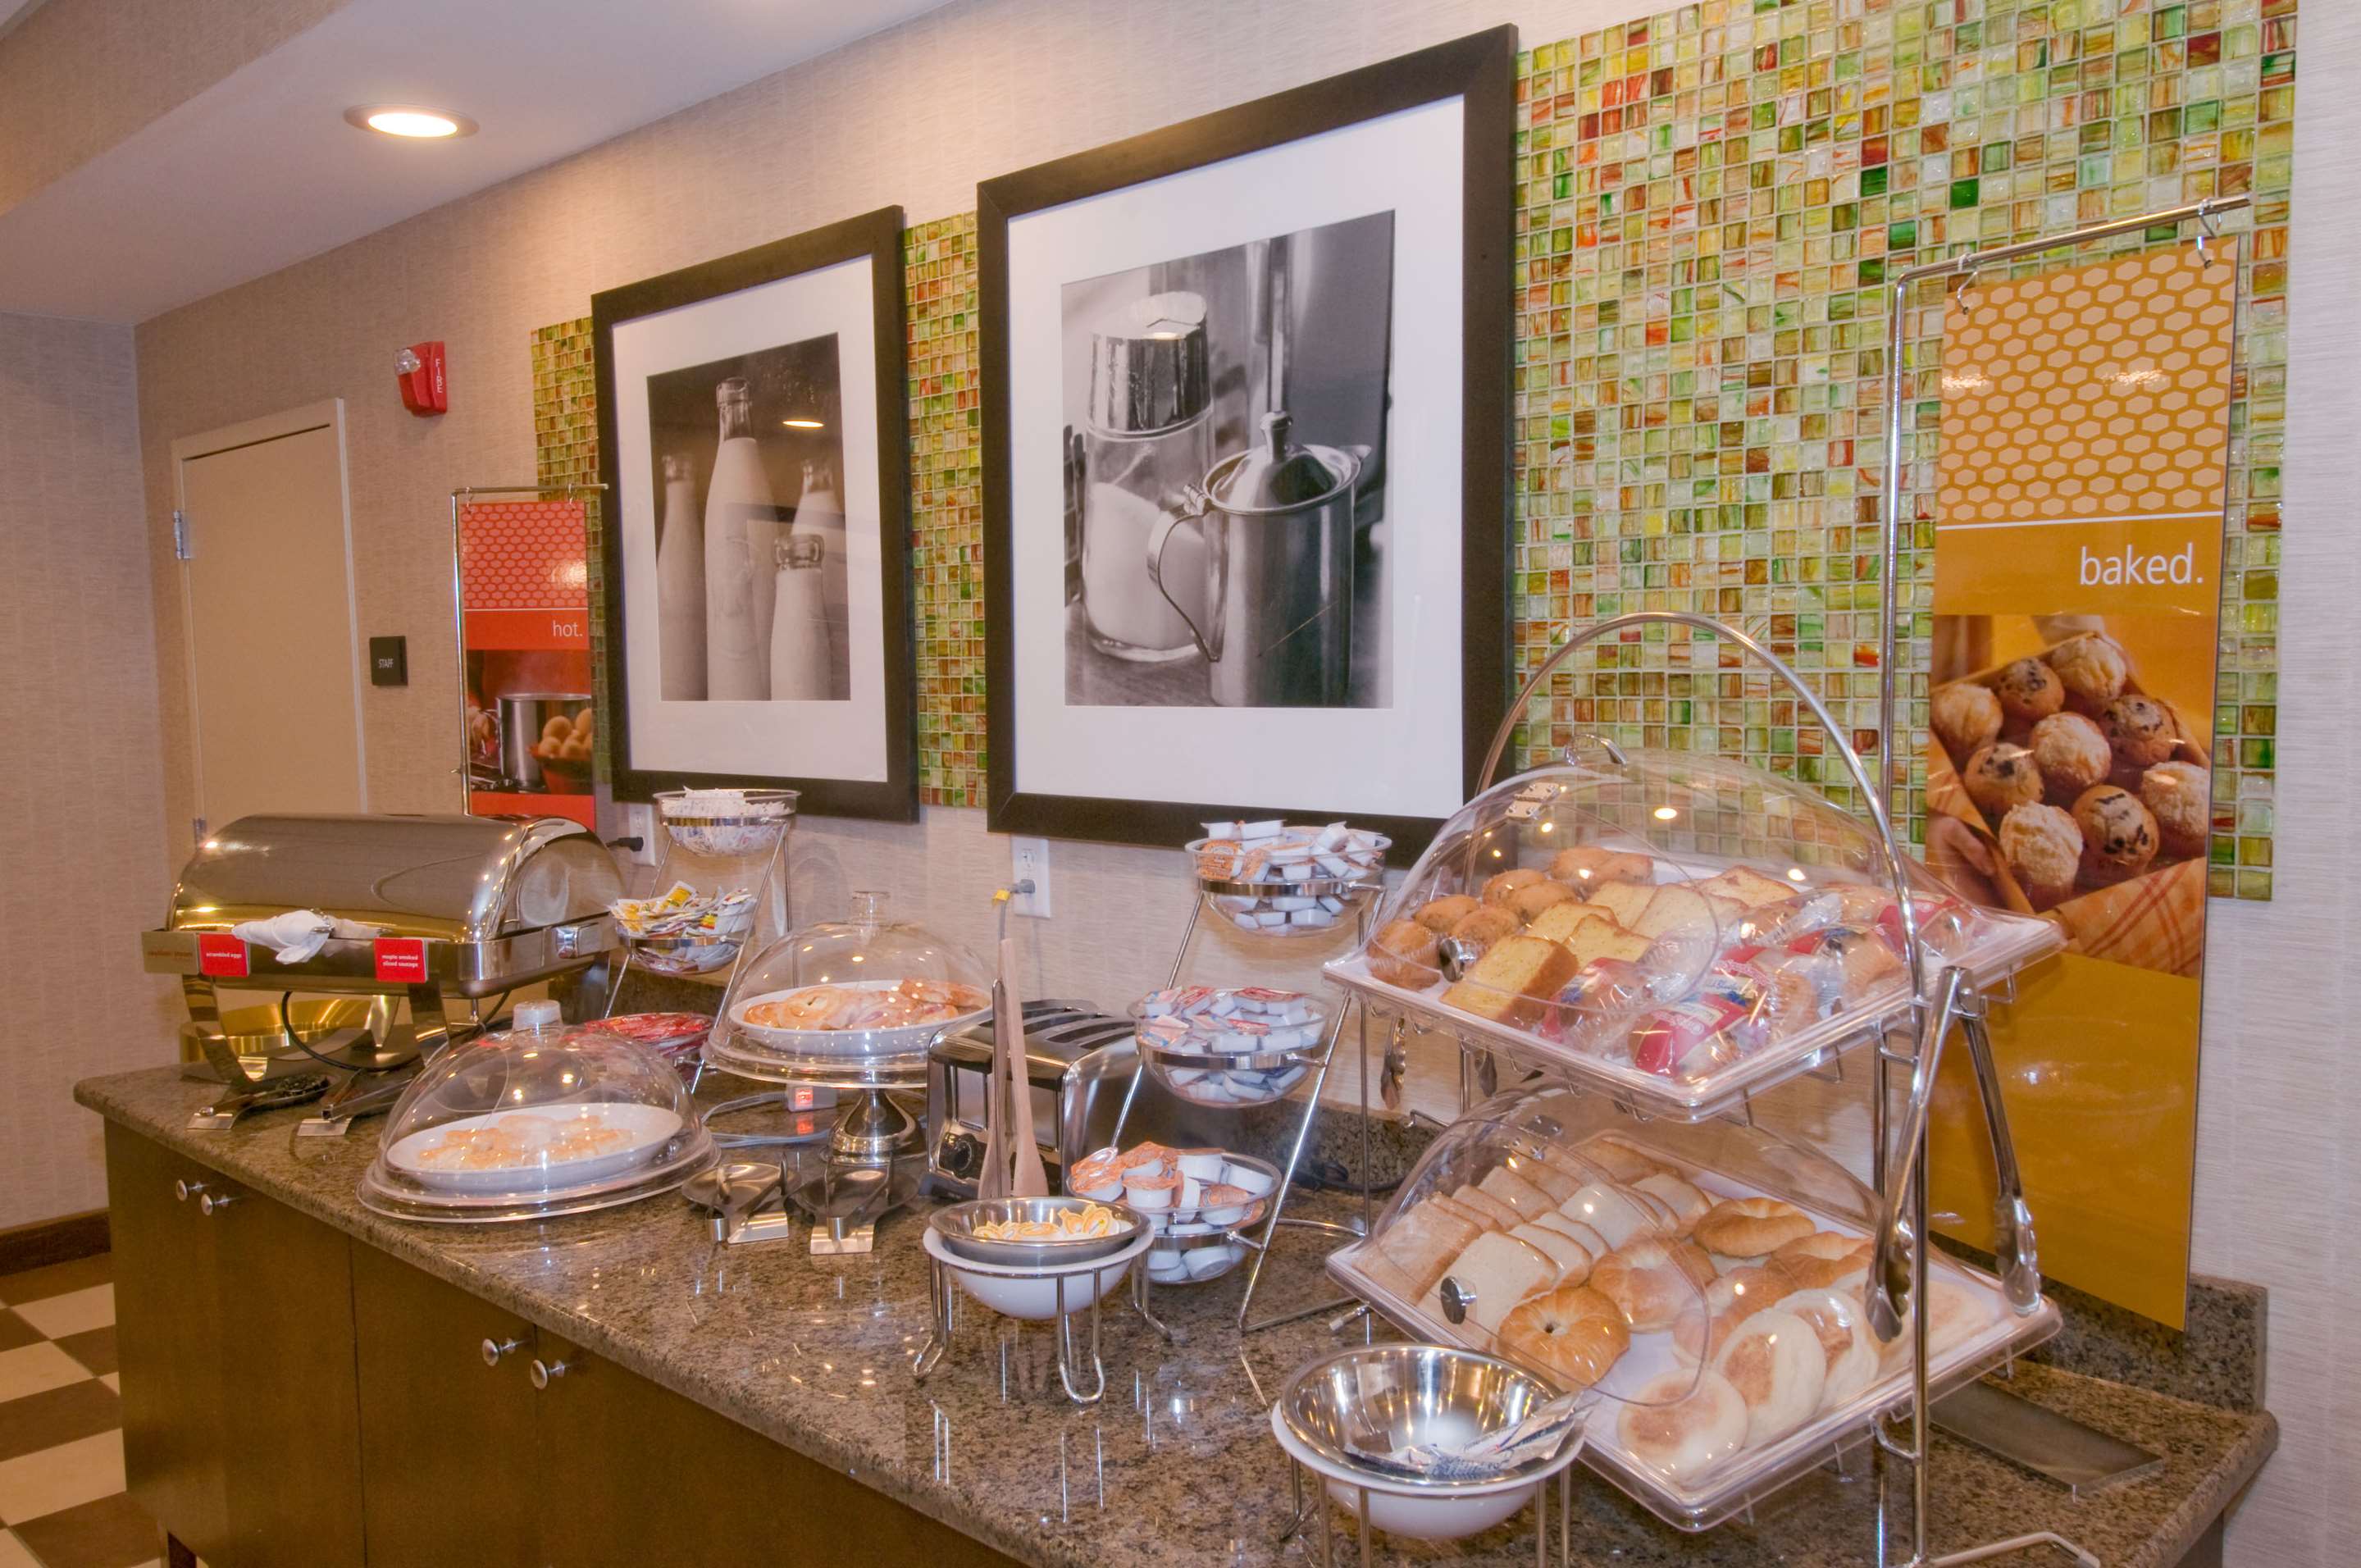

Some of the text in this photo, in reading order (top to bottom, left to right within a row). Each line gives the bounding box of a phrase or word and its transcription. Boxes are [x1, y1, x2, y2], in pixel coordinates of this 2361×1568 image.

[435, 358, 443, 394] FIRE
[2080, 541, 2204, 586] baked.
[553, 620, 583, 637] hot.
[378, 658, 394, 668] STAFF
